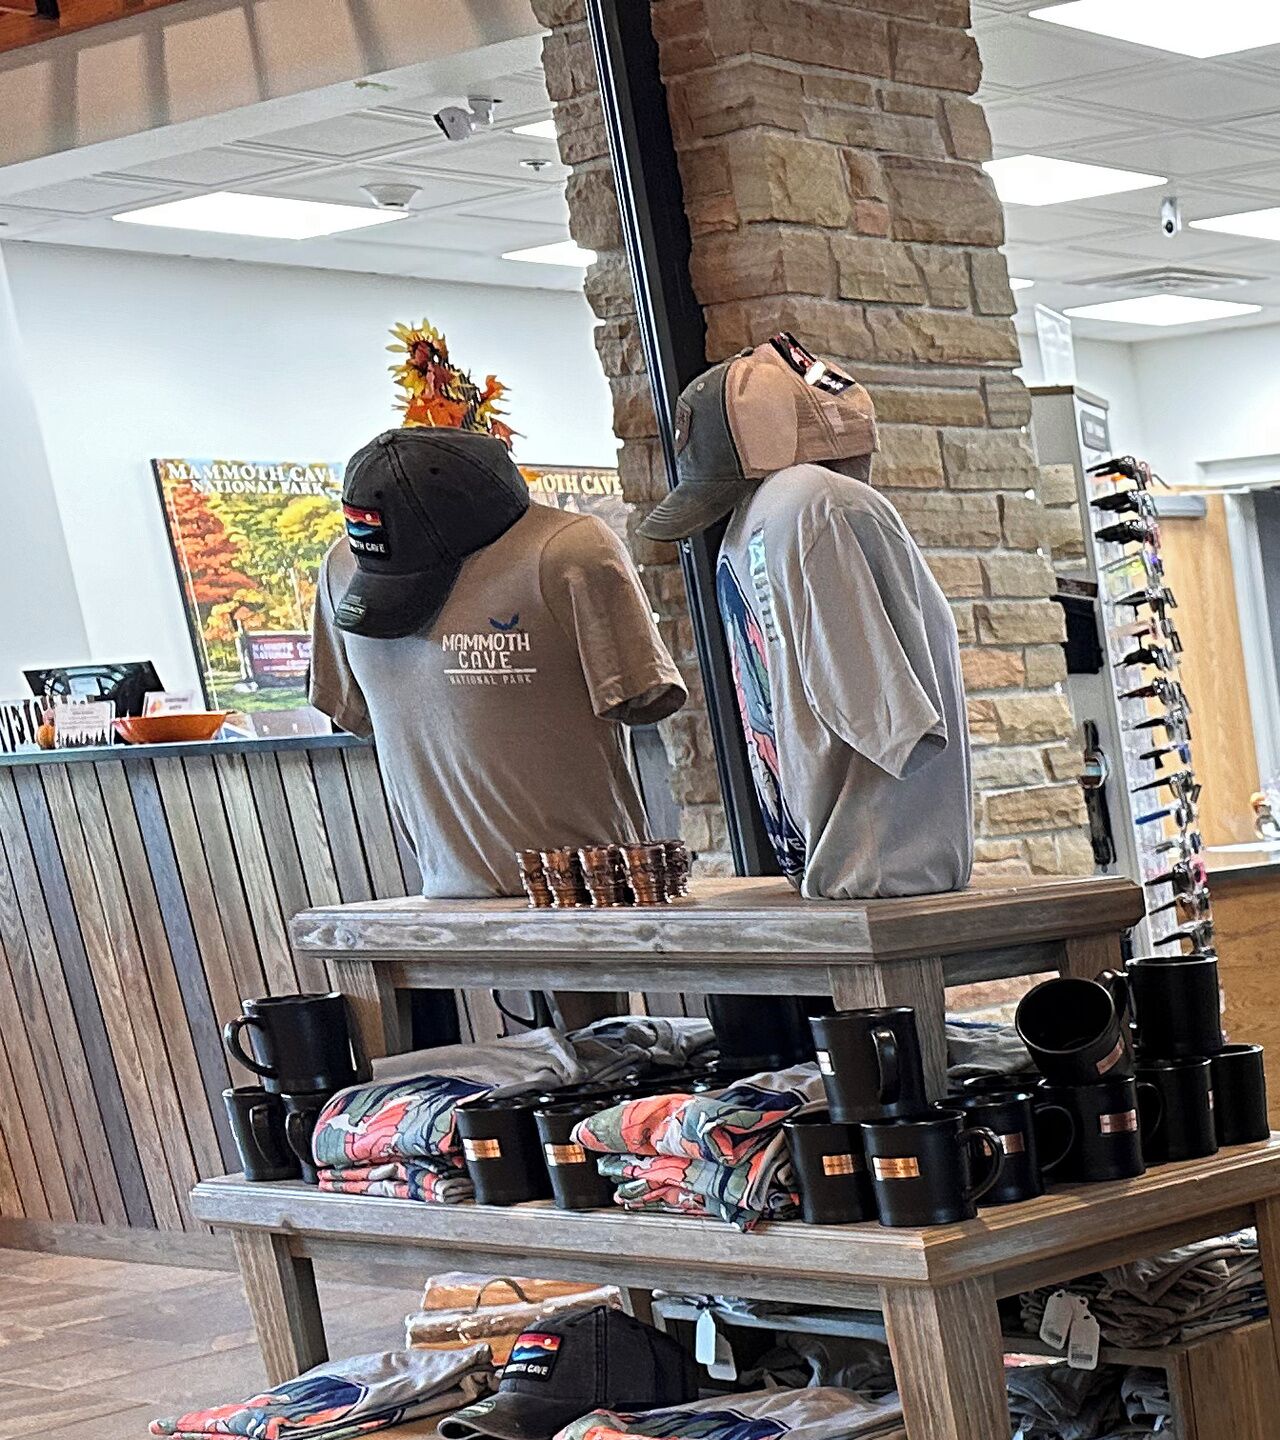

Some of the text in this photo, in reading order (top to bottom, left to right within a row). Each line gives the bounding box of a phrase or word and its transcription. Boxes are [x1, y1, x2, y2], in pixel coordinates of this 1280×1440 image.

[167, 463, 284, 482] MAMMOTH
[192, 479, 279, 494] NATIONAL
[442, 633, 530, 651] MAMMOTH
[458, 651, 512, 669] CAVE
[503, 674, 532, 684] PARK
